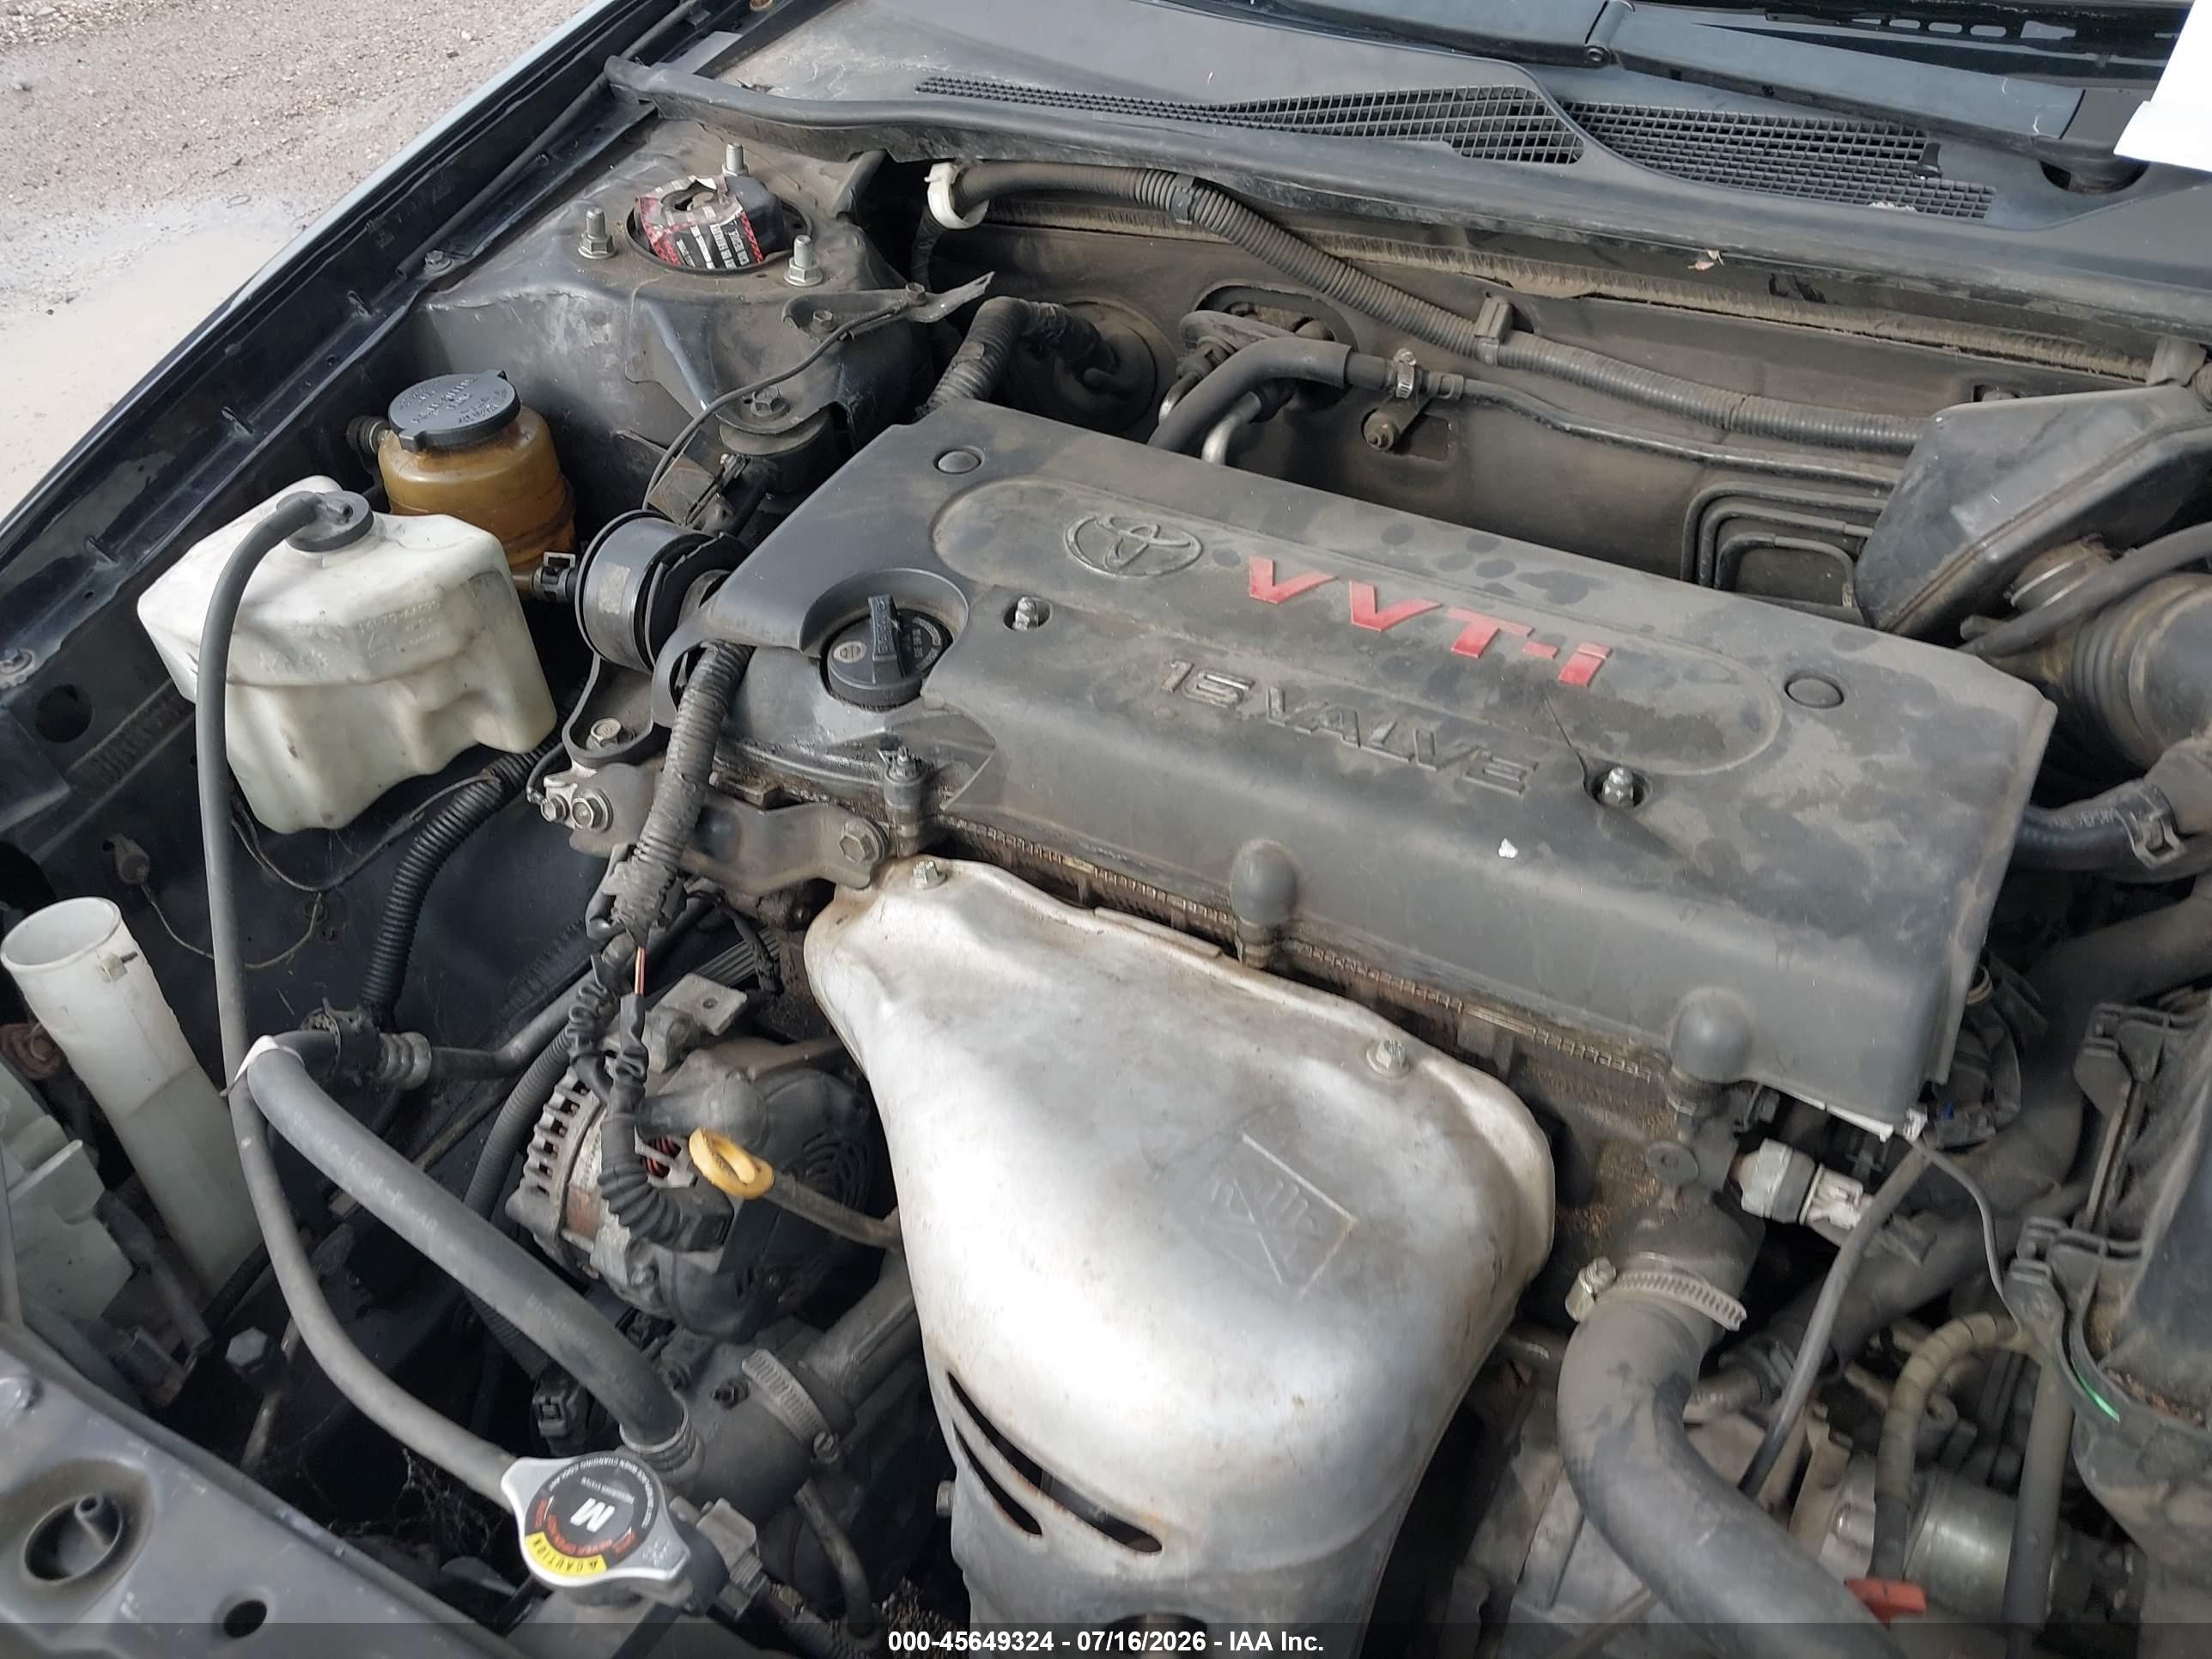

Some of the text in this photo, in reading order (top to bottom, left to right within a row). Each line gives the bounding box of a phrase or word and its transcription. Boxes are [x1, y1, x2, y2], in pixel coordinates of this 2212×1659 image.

[1249, 555, 1613, 688] VVT-i
[1161, 659, 1539, 796] 16 VALVE
[532, 1538, 584, 1573] CAUTION
